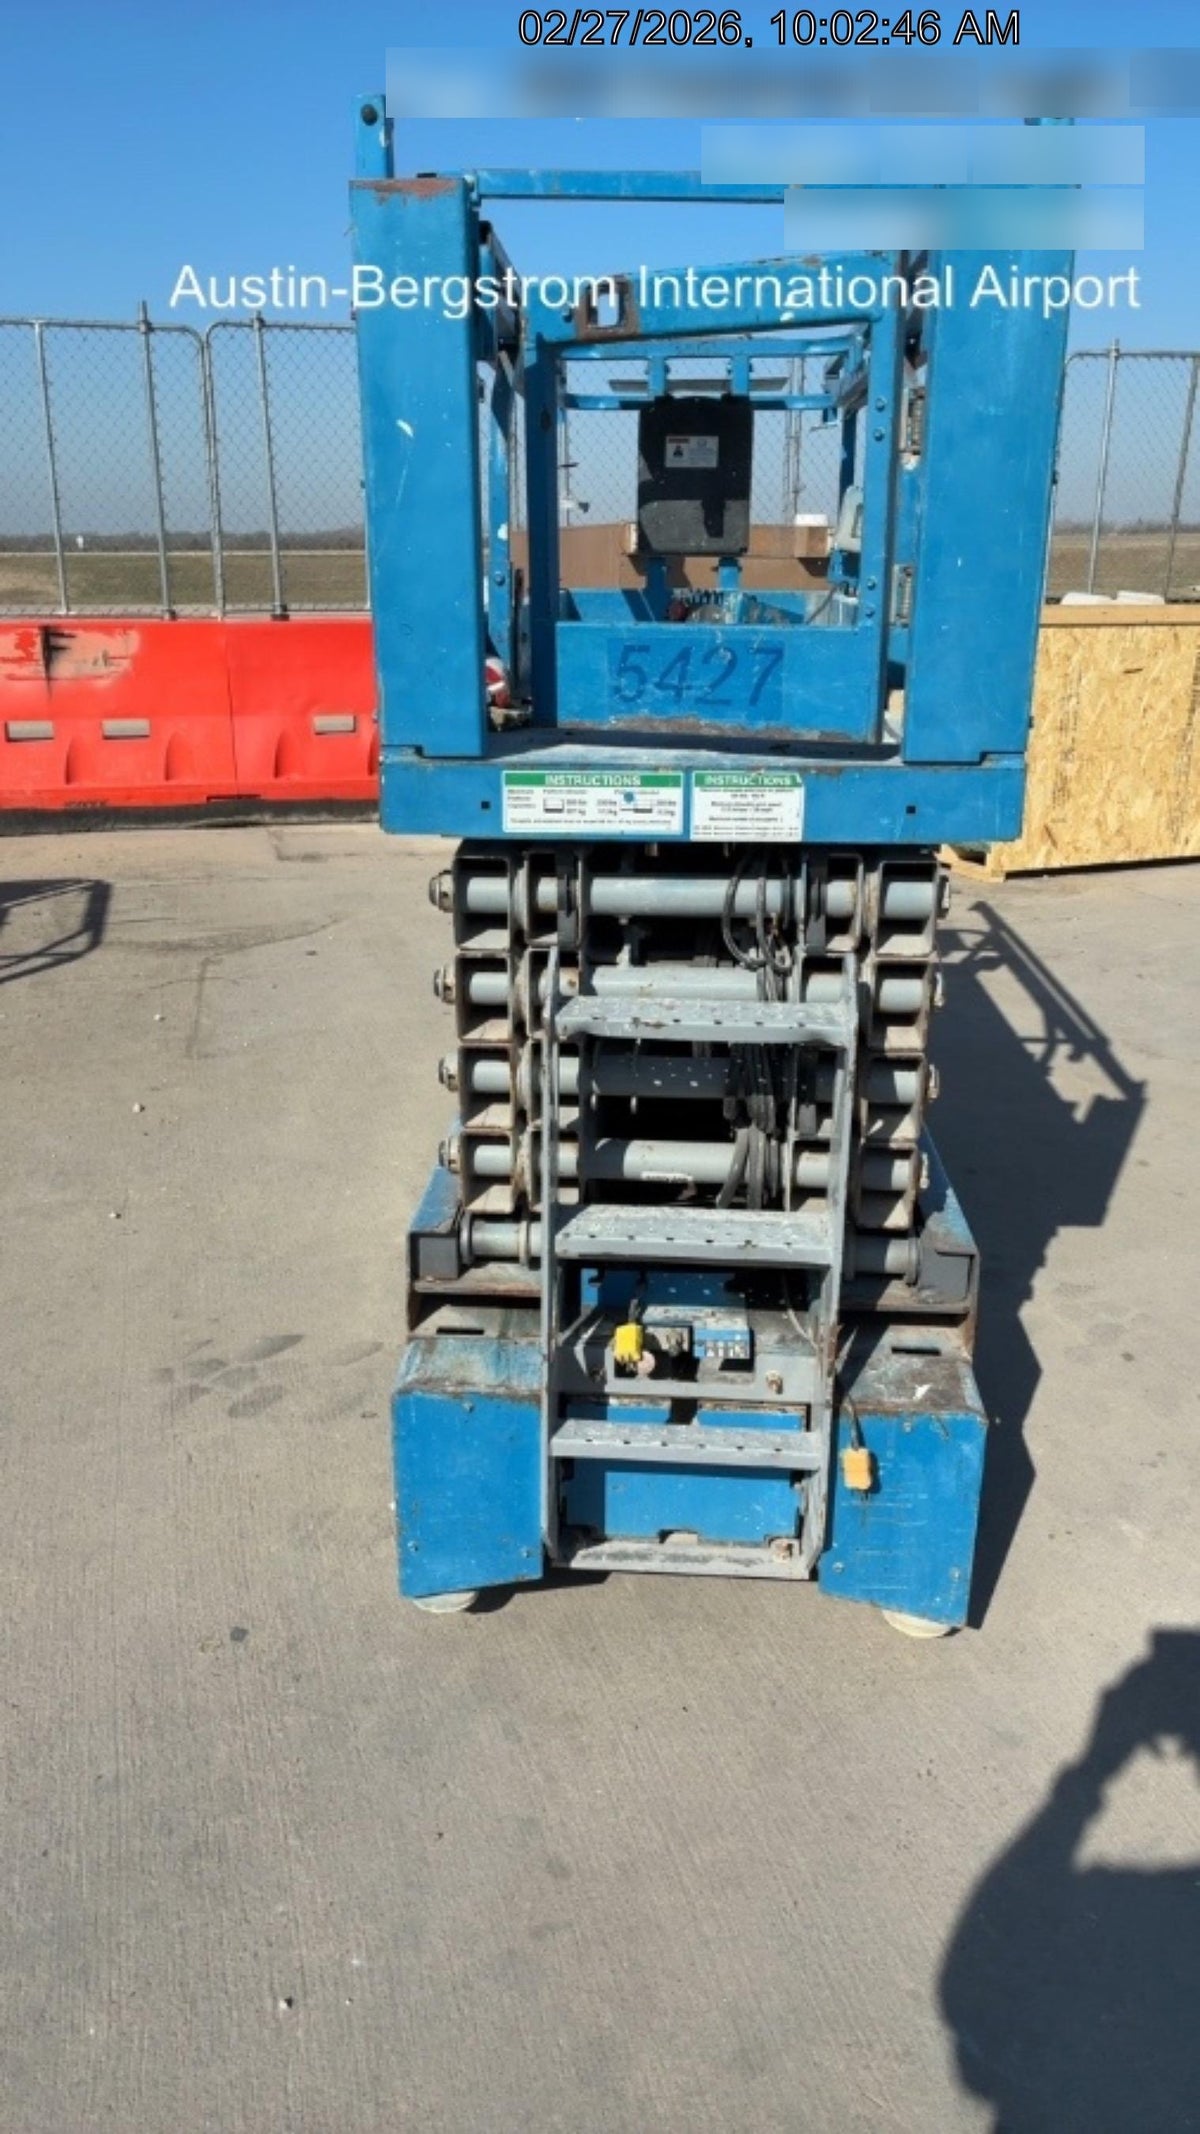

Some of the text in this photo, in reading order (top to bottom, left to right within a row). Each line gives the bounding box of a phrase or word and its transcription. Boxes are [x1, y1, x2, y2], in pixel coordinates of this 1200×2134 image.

[612, 643, 786, 706] 5427
[545, 774, 641, 786] INSTRUCTIONS
[704, 774, 793, 786] INSTRUCTIONS
